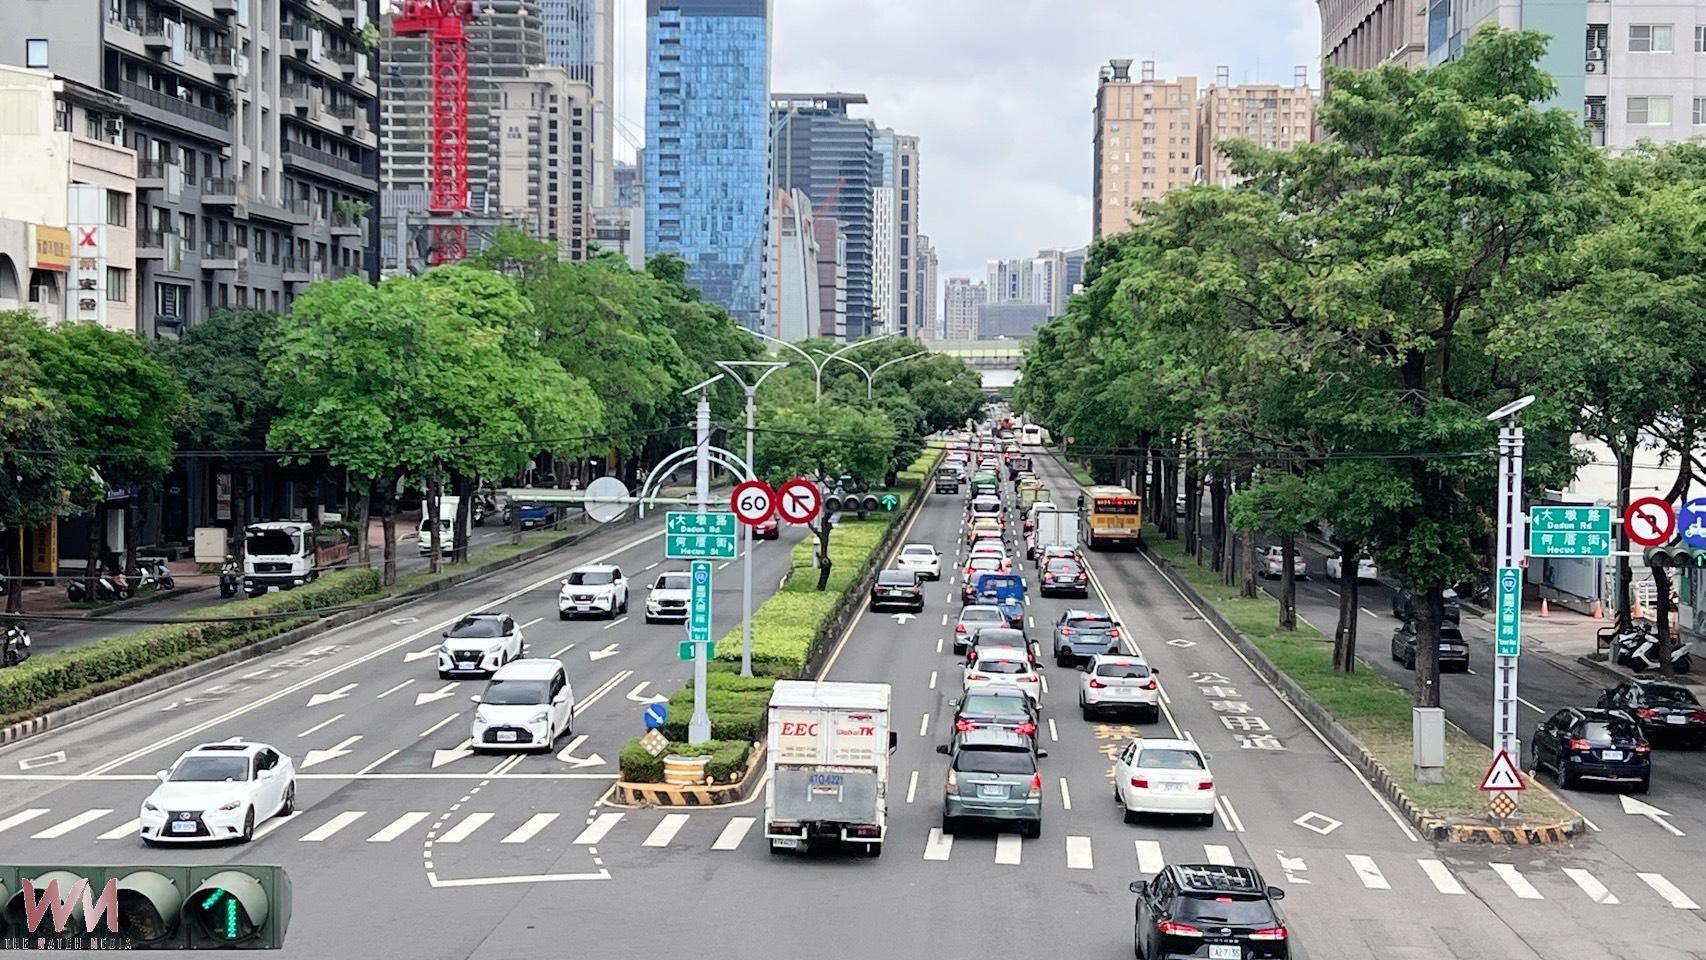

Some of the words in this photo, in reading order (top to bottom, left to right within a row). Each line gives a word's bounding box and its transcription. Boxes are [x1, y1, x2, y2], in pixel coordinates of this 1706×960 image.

[741, 496, 767, 511] 60
[676, 515, 727, 525] 大墩路
[1541, 509, 1600, 521] 大墩路
[1541, 533, 1600, 546] 何厝街
[1187, 672, 1287, 750] 公車專用道
[780, 722, 819, 736] EEC
